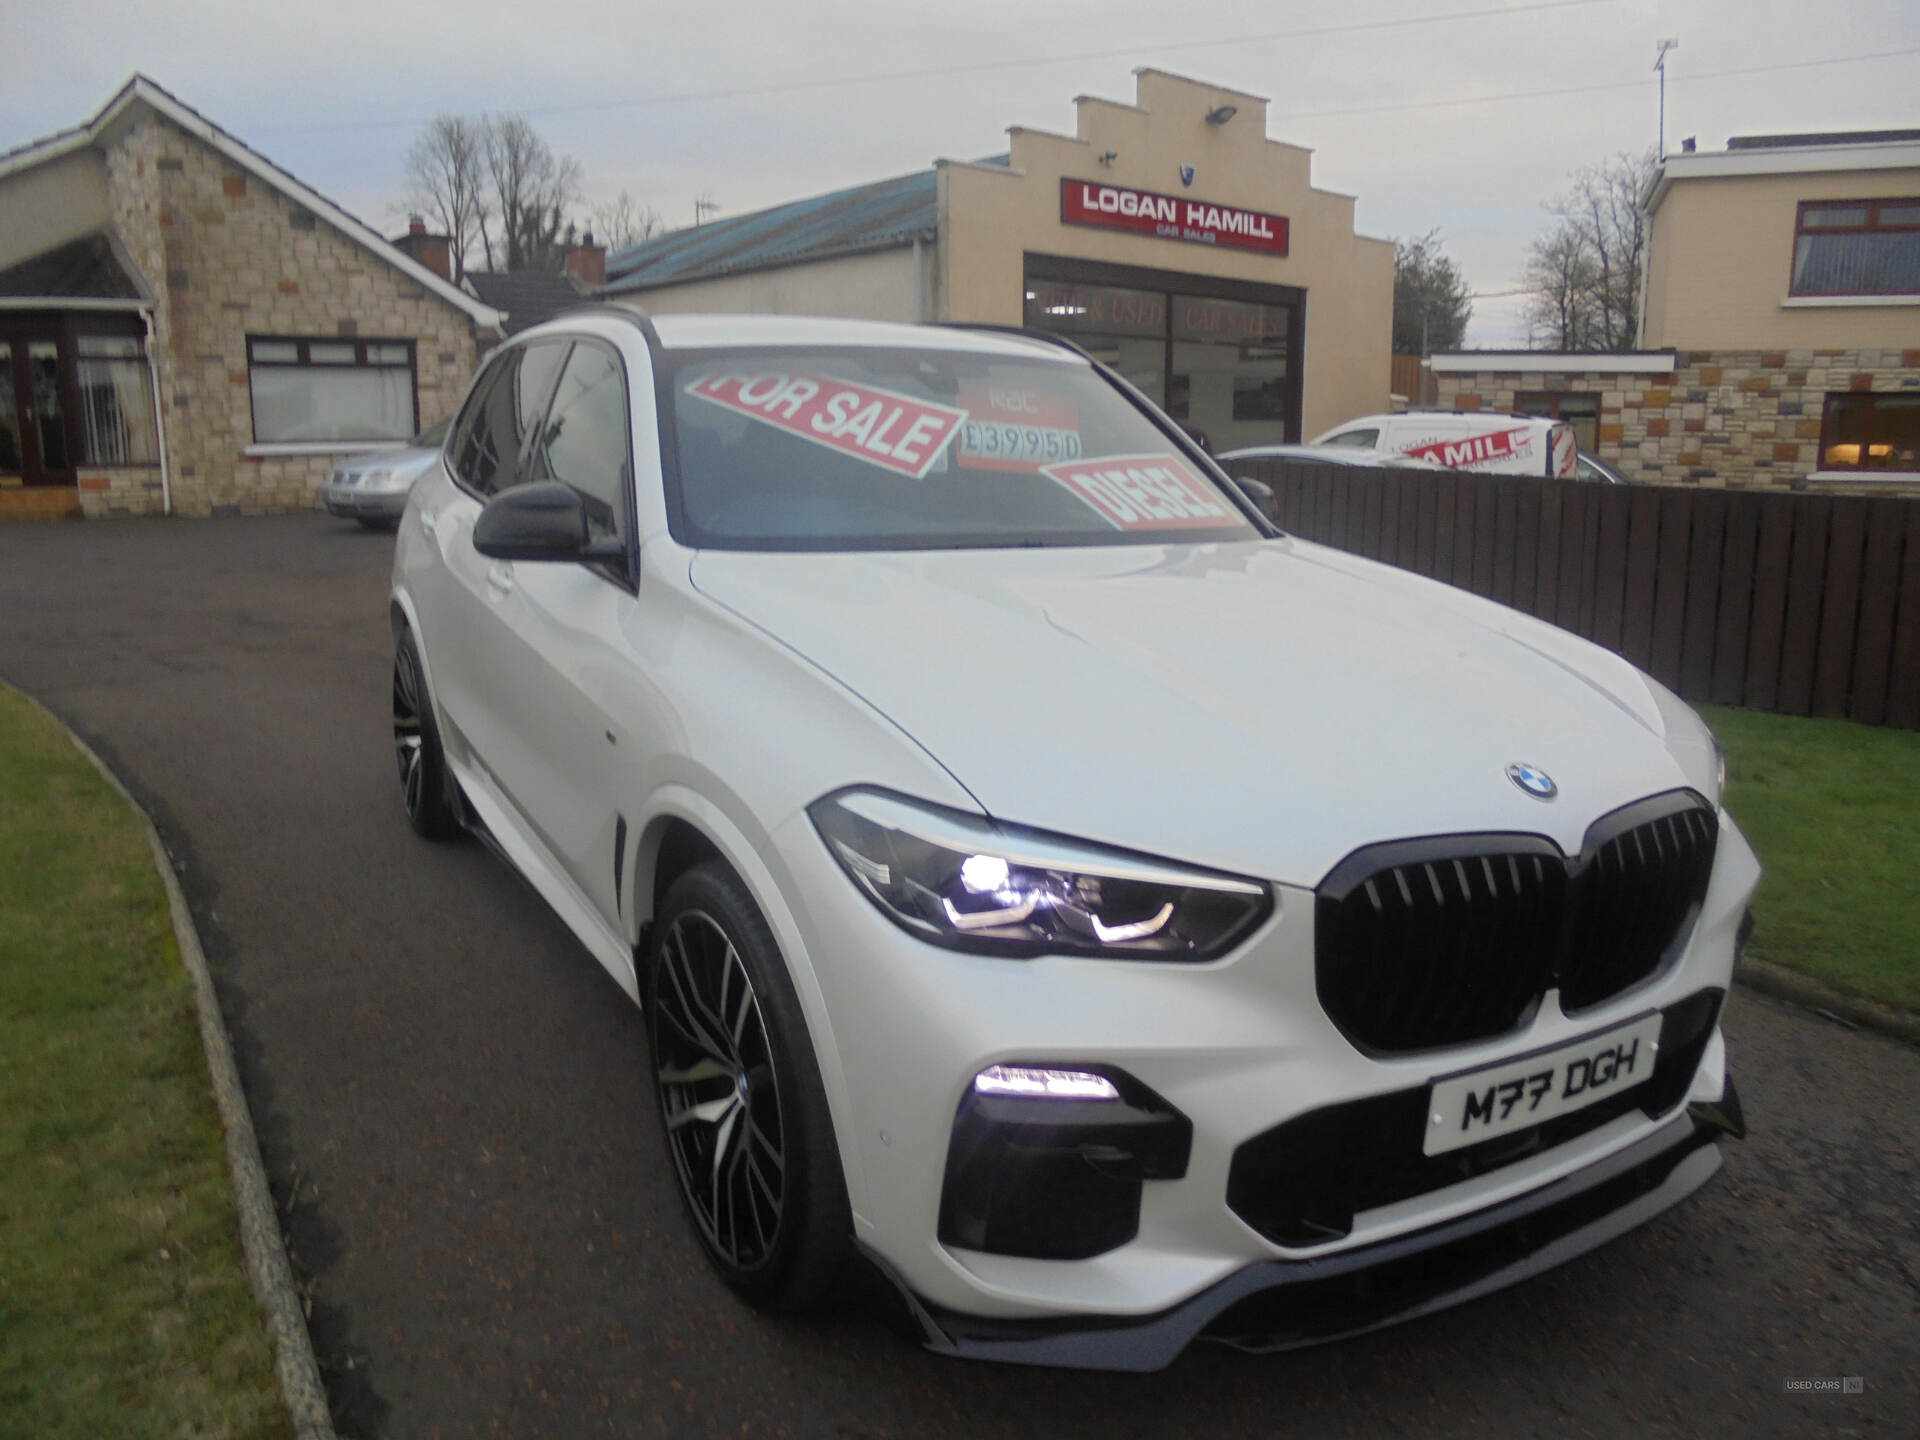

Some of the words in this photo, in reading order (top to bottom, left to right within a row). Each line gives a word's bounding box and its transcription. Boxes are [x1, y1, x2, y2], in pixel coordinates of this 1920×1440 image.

[1082, 184, 1176, 222] LOGAN
[1187, 202, 1275, 239] HAMILL
[1156, 223, 1179, 237] CAR
[811, 391, 945, 464] SALE
[965, 424, 1080, 459] £39950
[1421, 431, 1531, 467] AMILL
[1071, 467, 1226, 523] DIESEL
[1461, 1068, 1554, 1130] M77
[1562, 1037, 1639, 1099] DGH
